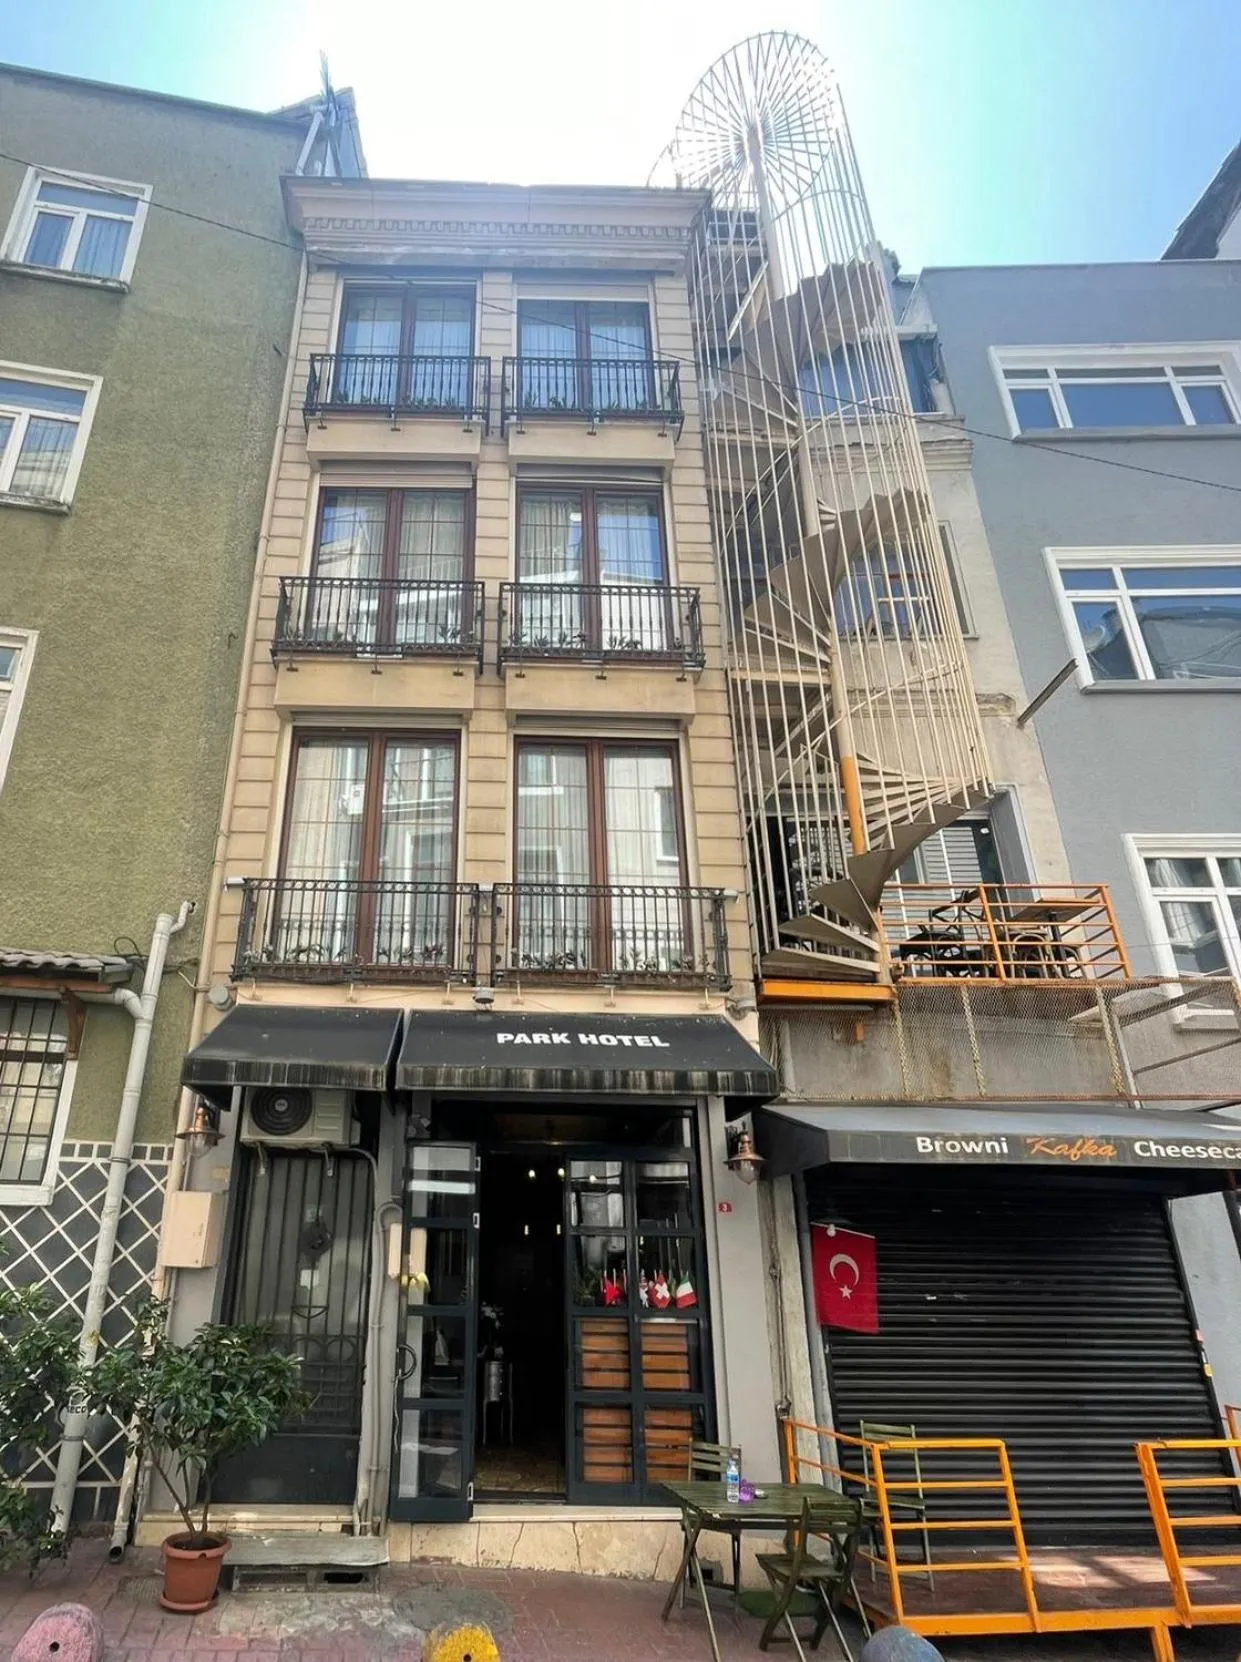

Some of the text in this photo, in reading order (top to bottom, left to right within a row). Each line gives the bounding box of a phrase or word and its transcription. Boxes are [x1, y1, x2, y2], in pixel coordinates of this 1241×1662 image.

[496, 1032, 671, 1048] PARK HOTEL
[916, 1136, 1009, 1154] Browni
[1026, 1137, 1117, 1161] Kafka
